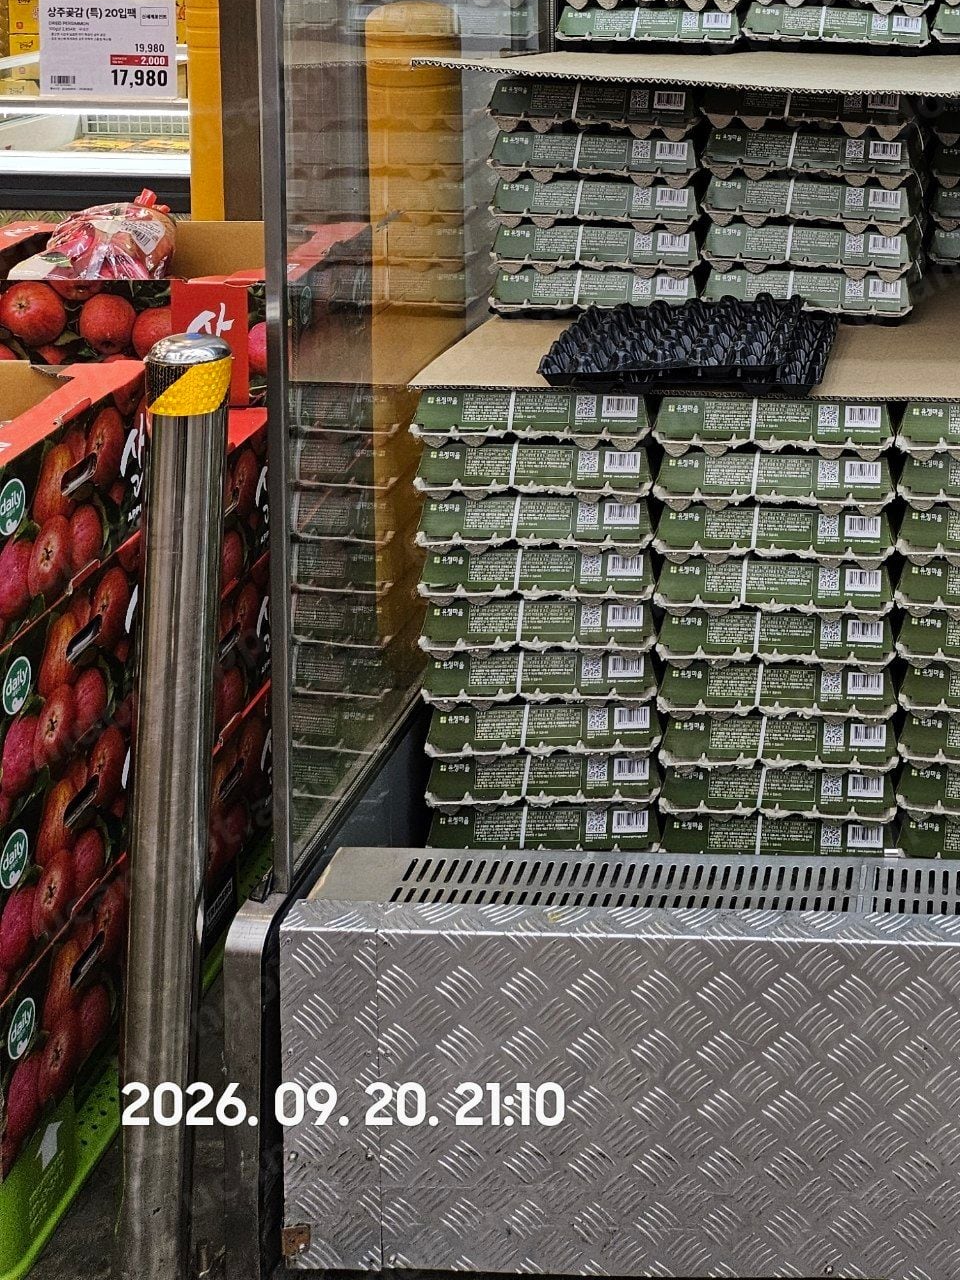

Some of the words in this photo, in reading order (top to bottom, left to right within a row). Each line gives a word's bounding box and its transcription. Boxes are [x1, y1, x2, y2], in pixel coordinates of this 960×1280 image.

[48, 7, 83, 18] 상주곶감
[86, 8, 102, 18] (특)
[105, 8, 136, 18] 20입팩
[135, 43, 164, 53] 19,980
[140, 56, 165, 66] 2,000
[111, 69, 168, 88] 17,980
[0, 490, 22, 517] daily
[6, 666, 28, 696] daily
[3, 838, 26, 871] daily
[11, 1008, 33, 1044] daily
